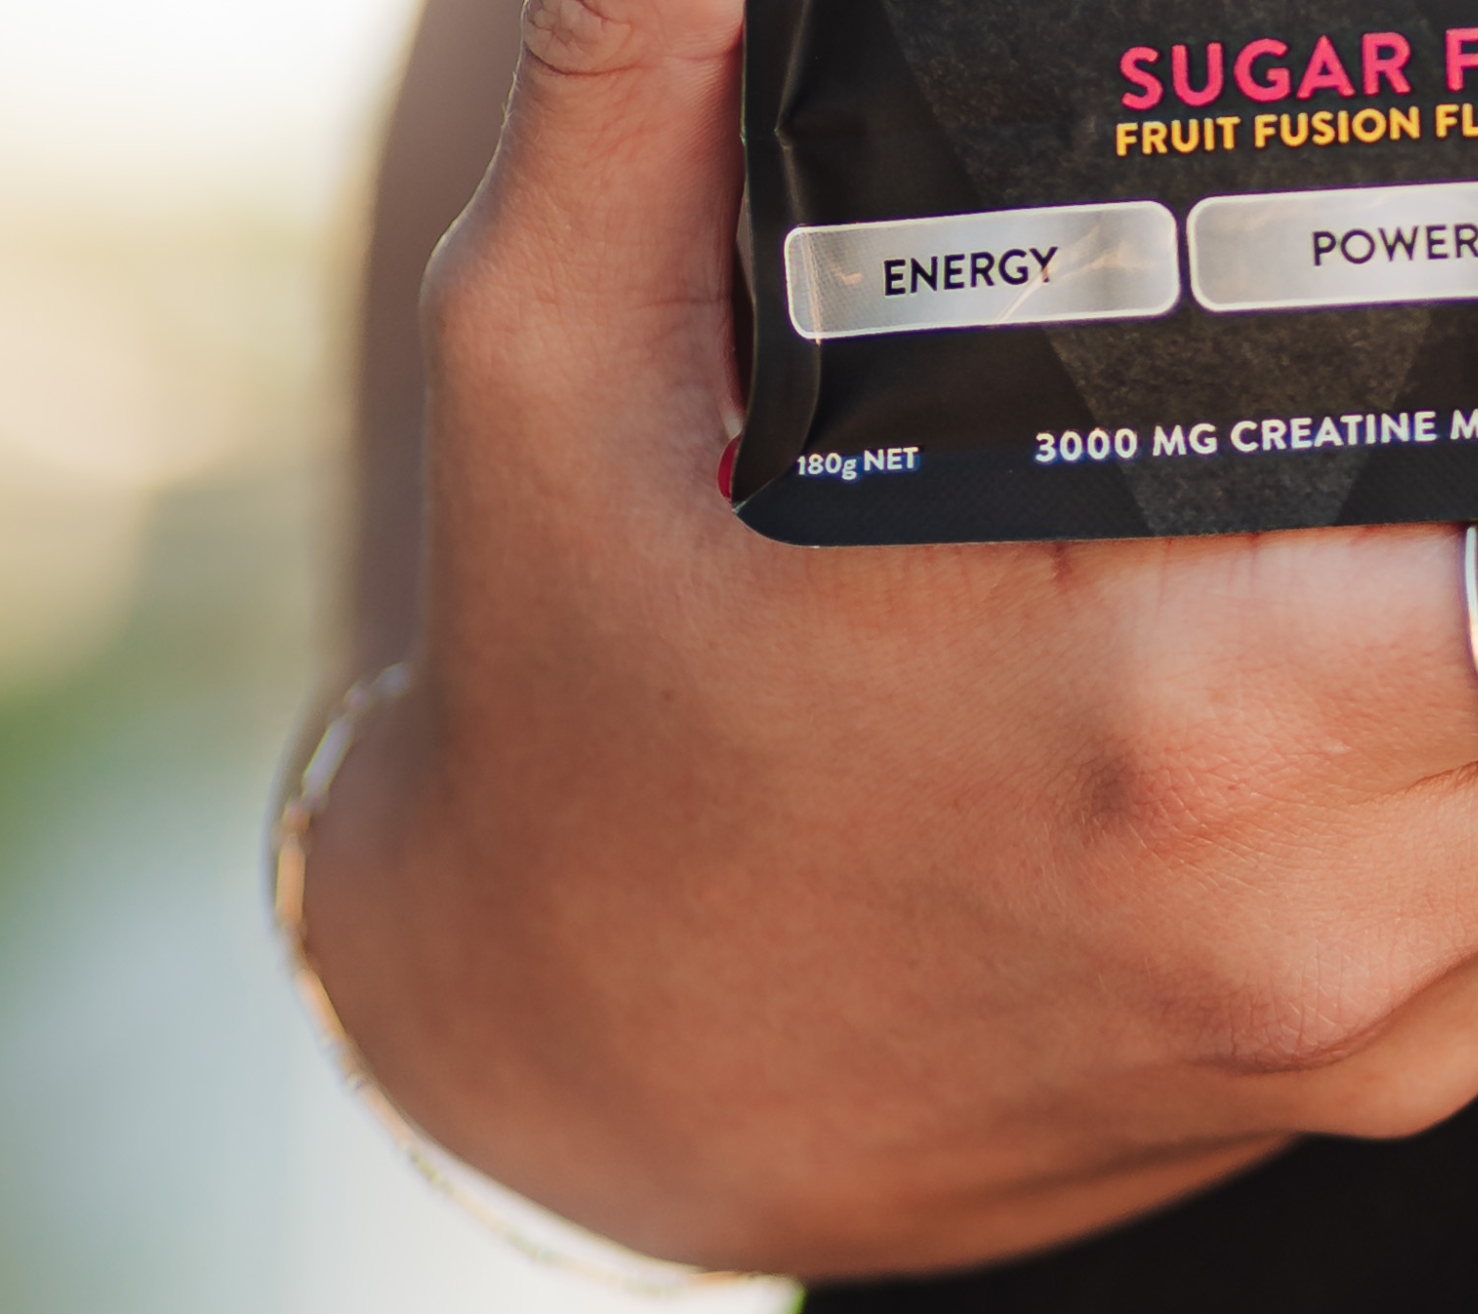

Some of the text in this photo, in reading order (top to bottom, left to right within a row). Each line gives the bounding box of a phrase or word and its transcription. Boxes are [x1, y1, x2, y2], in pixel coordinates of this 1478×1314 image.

[1120, 30, 1412, 111] SUGAR
[1115, 113, 1239, 157] FRUIT
[1253, 104, 1421, 149] FUSION
[883, 246, 1058, 297] ENERGY
[797, 446, 919, 480] 180g NET
[1034, 428, 1138, 464] 3000
[1152, 422, 1218, 457] MG
[1230, 410, 1437, 454] CREATINE
